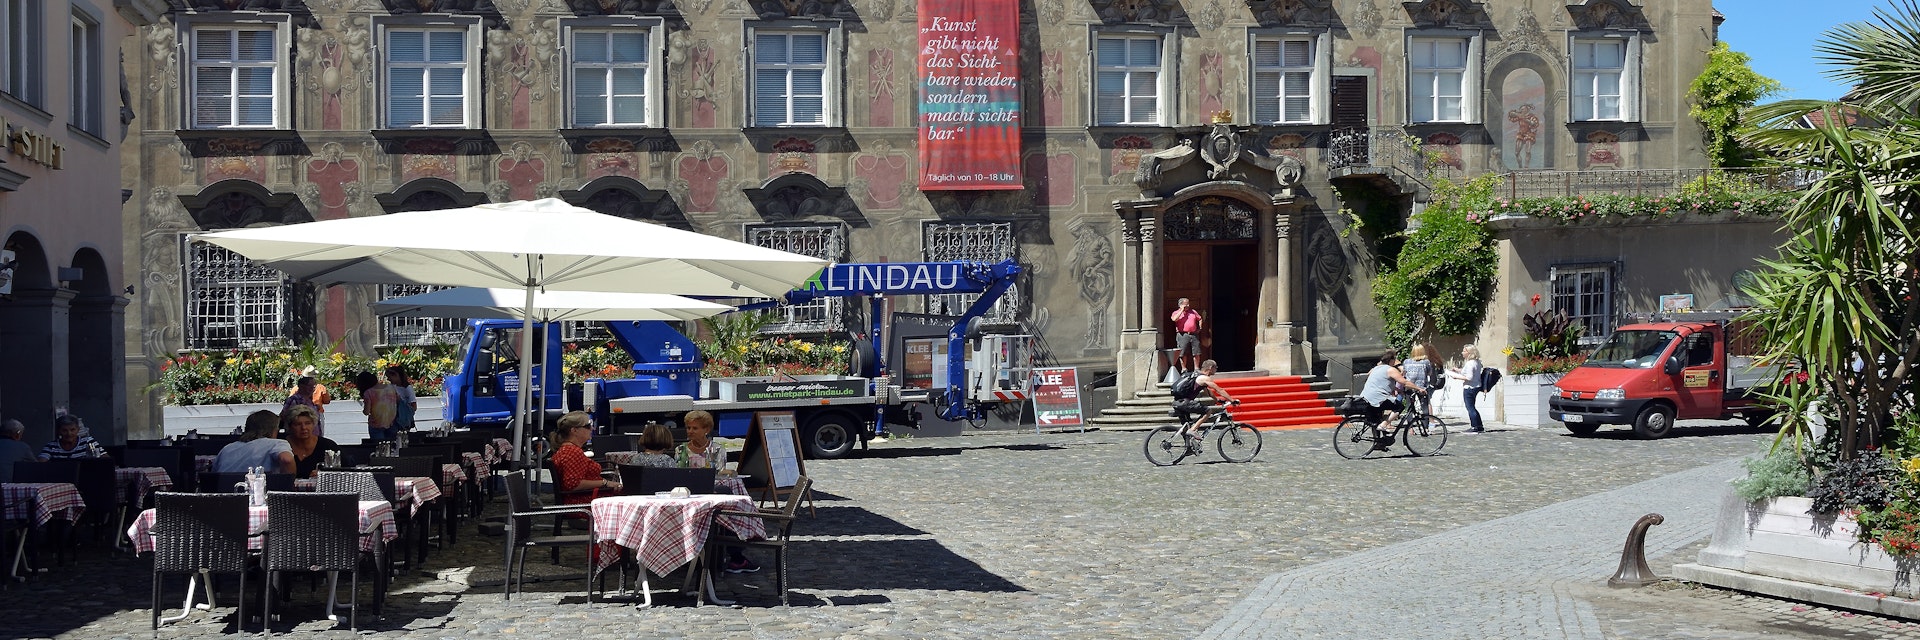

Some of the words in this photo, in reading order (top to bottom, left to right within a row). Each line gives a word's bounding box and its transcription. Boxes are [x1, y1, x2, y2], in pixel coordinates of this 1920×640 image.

[926, 36, 957, 54] gibt
[961, 36, 999, 51] nicht
[926, 53, 953, 68] das
[958, 53, 1001, 69] Sicht-
[927, 72, 960, 86] bare
[964, 72, 1017, 88] wieder,
[926, 90, 988, 104] sondern
[927, 108, 974, 122] macht
[978, 108, 1018, 122] sicht-
[927, 173, 955, 183] Täglich
[1000, 173, 1014, 181] Uhr
[907, 344, 929, 354] KLEE
[1033, 374, 1063, 385] KLEE
[748, 388, 854, 399] www.mietpark-lindau.de
